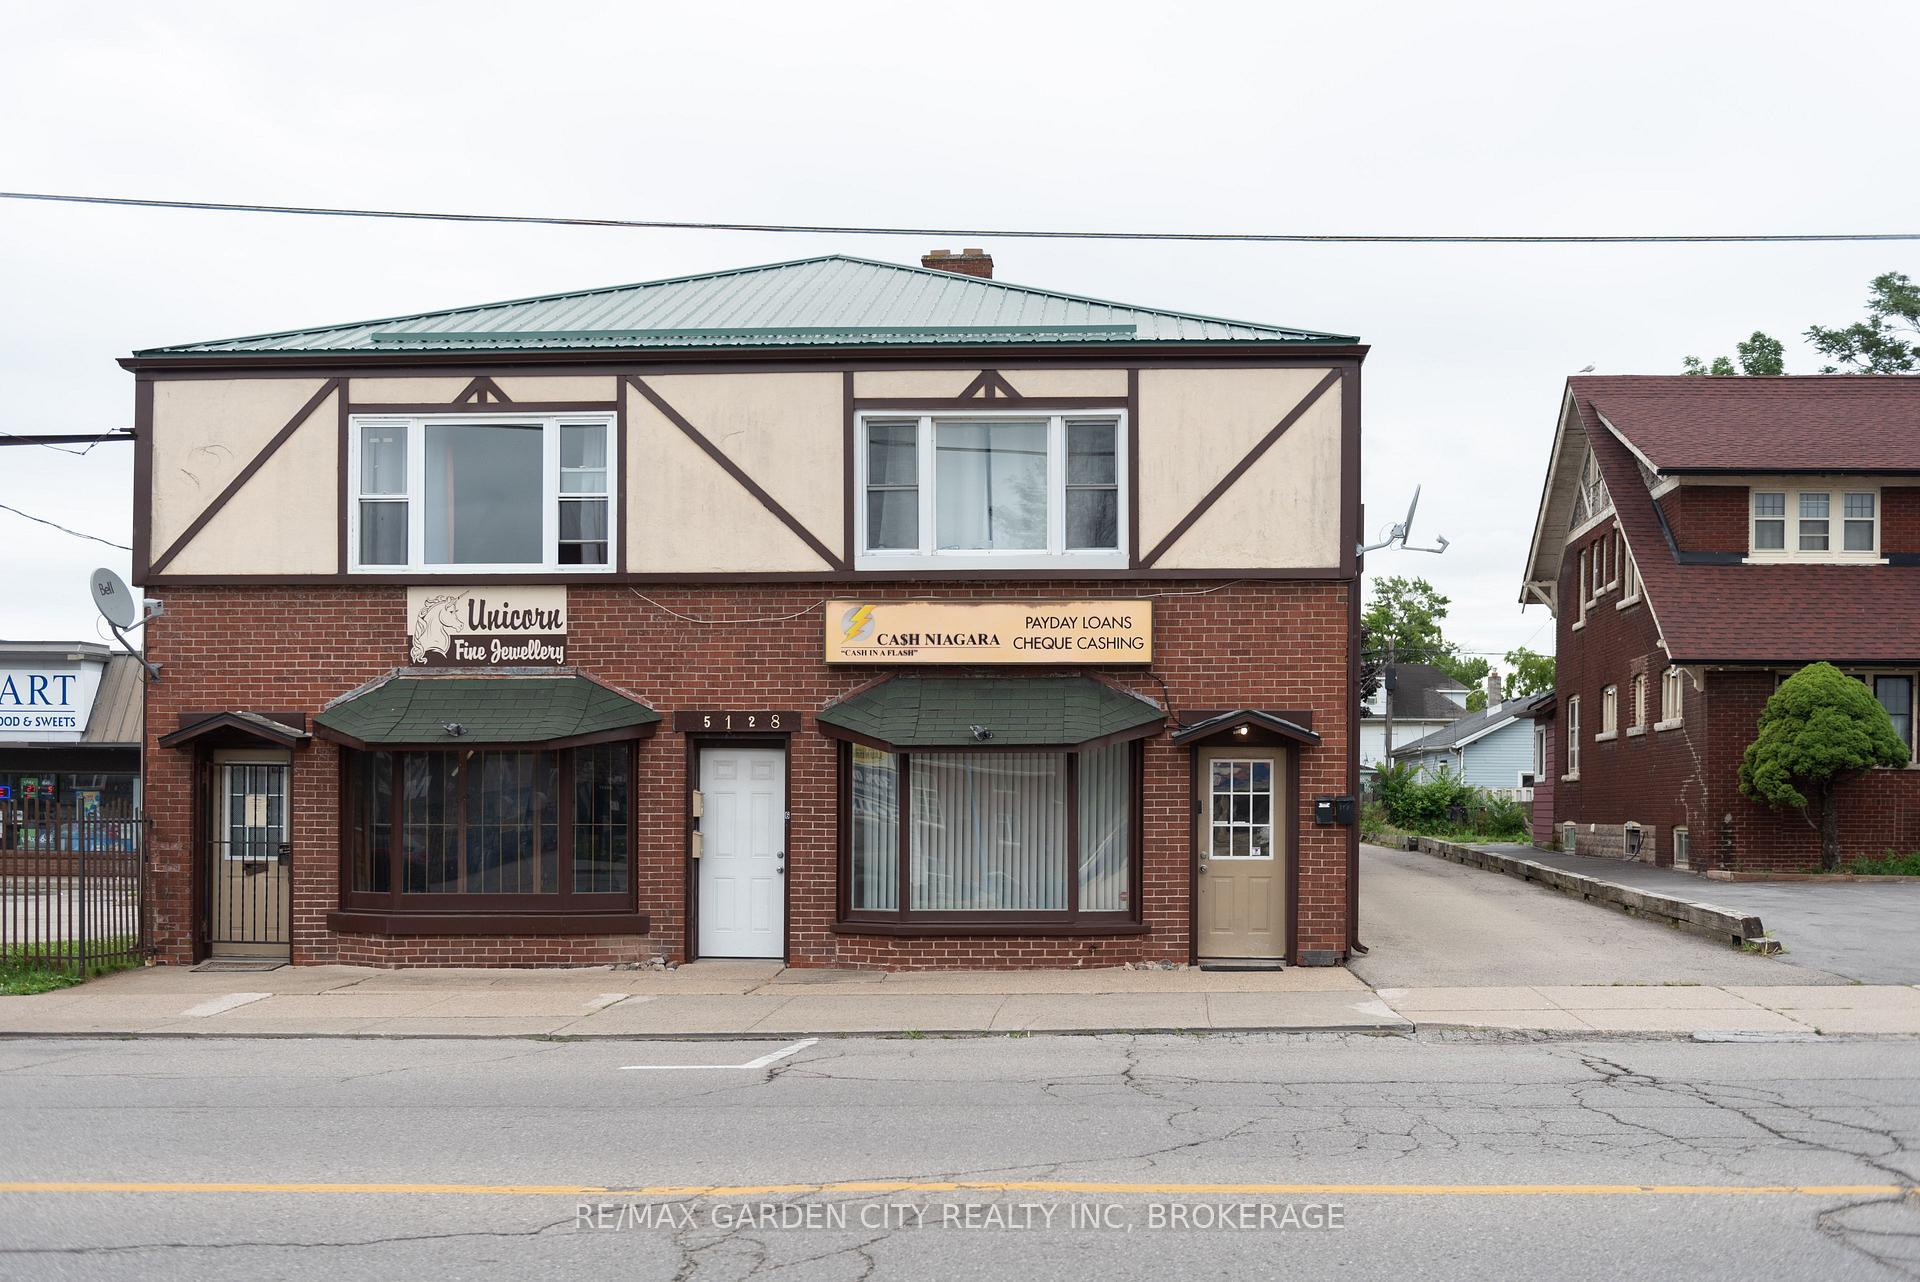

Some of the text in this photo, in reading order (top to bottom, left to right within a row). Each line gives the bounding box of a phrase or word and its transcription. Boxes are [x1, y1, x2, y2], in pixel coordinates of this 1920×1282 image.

[98, 581, 114, 596] Bell
[468, 598, 563, 631] Unicorn
[1025, 616, 1132, 629] PAYDAY LOANS
[925, 633, 1000, 646] NIAGARA
[1013, 637, 1144, 650] CHEQUE CASHING
[454, 639, 564, 664] Fine Jewellery
[0, 674, 76, 706] ART
[23, 716, 32, 727] &
[35, 716, 76, 727] SWEETS
[703, 714, 780, 730] 5128
